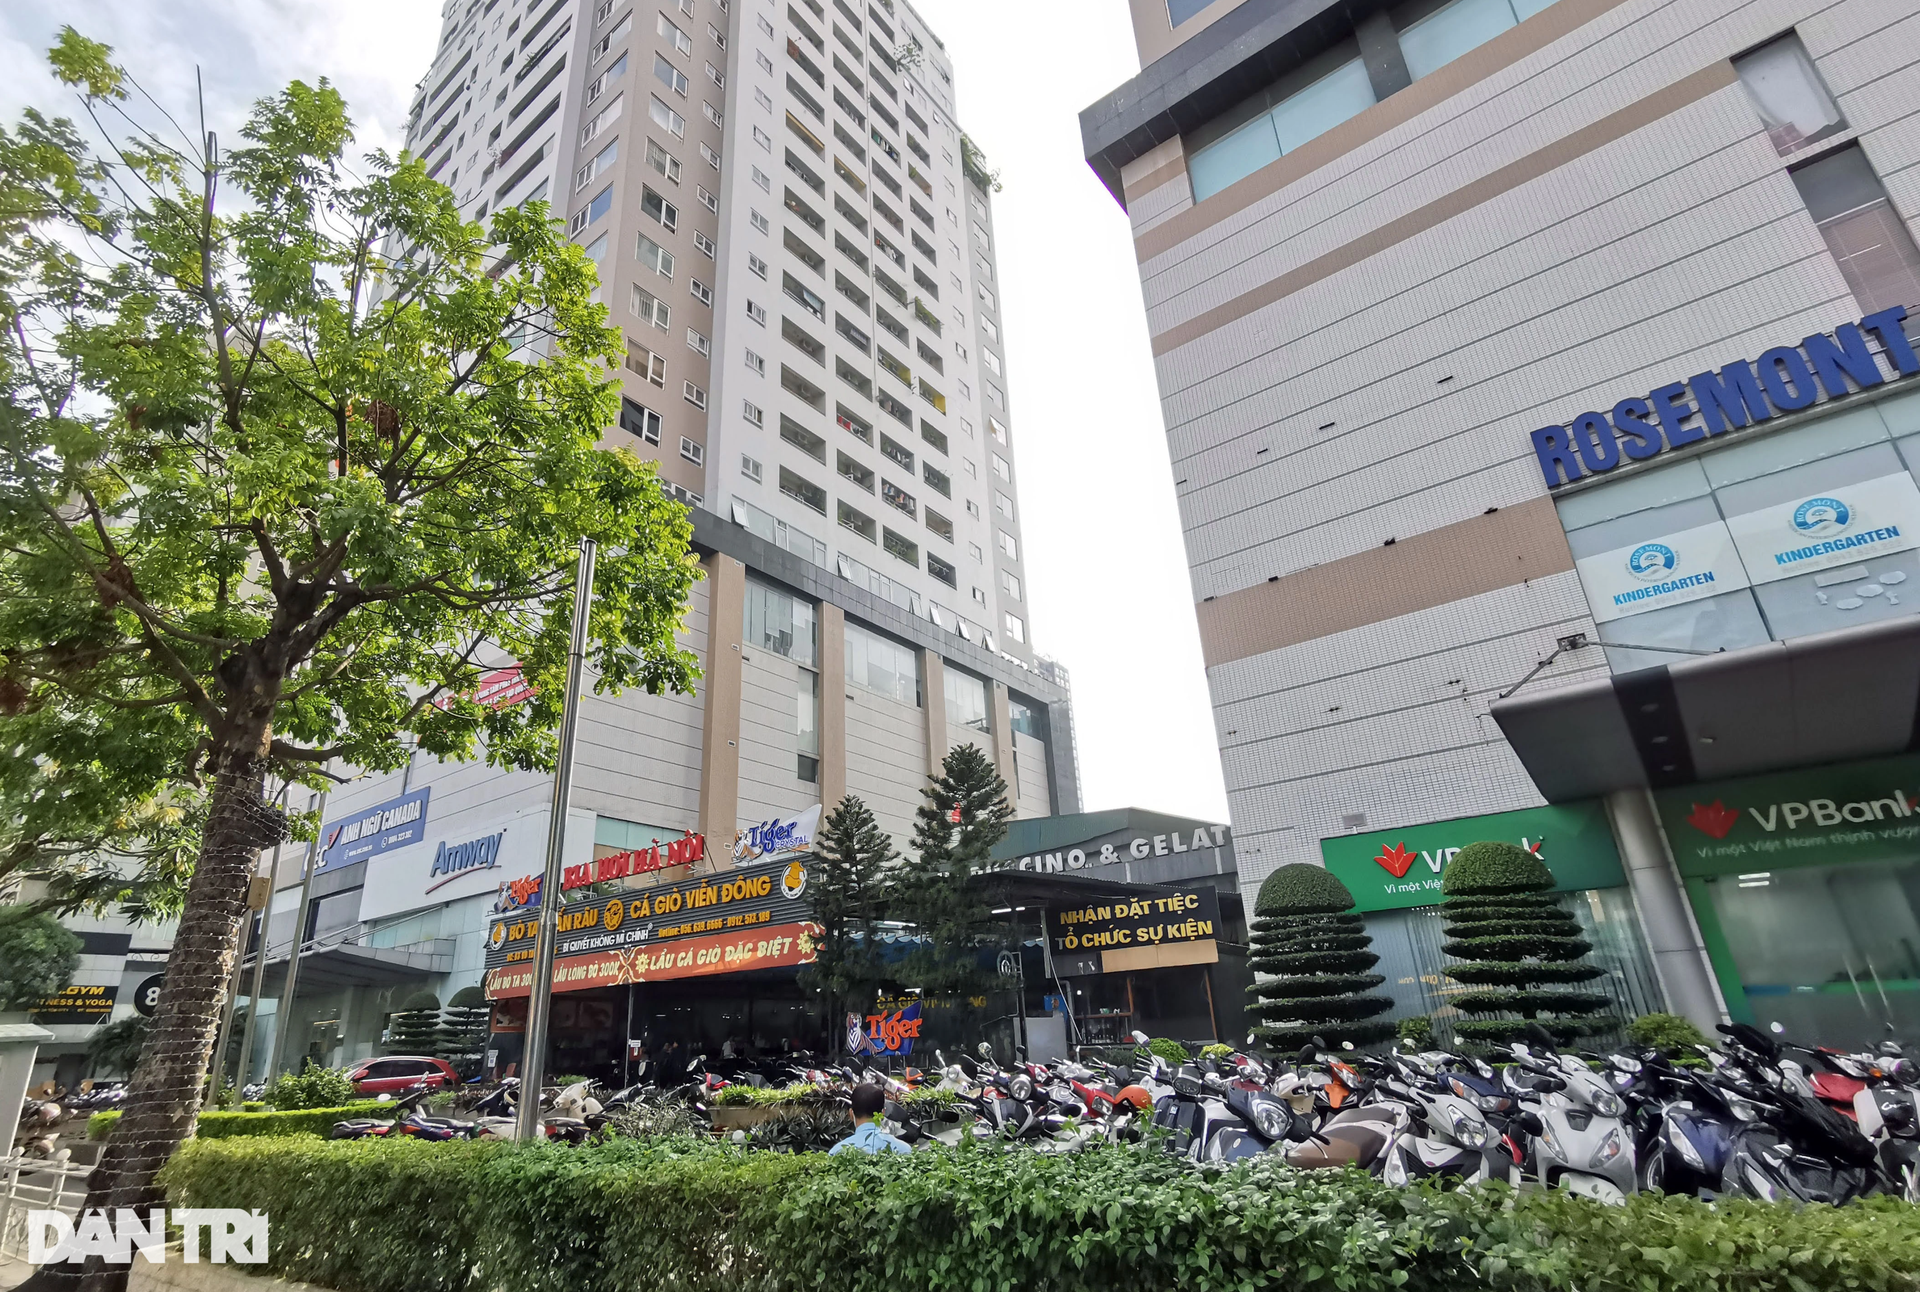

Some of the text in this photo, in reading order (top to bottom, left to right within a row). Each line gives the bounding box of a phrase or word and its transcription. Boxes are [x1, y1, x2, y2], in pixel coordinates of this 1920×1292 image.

[1530, 305, 1920, 489] ROSEMONT
[1774, 526, 1900, 565] KINDERGARTEN
[1613, 571, 1715, 605] KINDERGARTEN
[341, 822, 360, 845] ANH
[361, 810, 382, 838] NGỮ
[382, 800, 422, 829] CANADA
[430, 832, 502, 878] Amway
[775, 835, 808, 849] CRYSTAL
[1100, 844, 1122, 865] &
[562, 862, 593, 891] BIA
[633, 838, 663, 873] HÀ
[667, 829, 705, 870] NỘI
[510, 875, 541, 905] Tiger
[1384, 883, 1396, 894] Vì
[1398, 882, 1421, 893] một
[509, 919, 526, 941] BÒ
[574, 906, 599, 929] RÂU
[630, 893, 650, 919] CÁ
[654, 887, 682, 914] GIÒ
[685, 879, 718, 908] VIỄN
[721, 875, 772, 904] ĐÔNG
[1060, 892, 1199, 925] NHẬN ĐẶT TIỆC
[590, 932, 615, 949] KHÔNG
[615, 930, 625, 944] MÌ
[626, 927, 649, 942] CHÍNH
[1055, 919, 1213, 950] TỔ CHỨC SỰ KIỆN
[650, 936, 792, 970] LẨU CÁ GIÒ ĐẶC BIỆT
[502, 972, 512, 989] BÒ
[512, 975, 521, 988] TA
[554, 960, 620, 983] LẨU LÒNG BÒ 300K
[866, 1010, 922, 1050] Tiger
